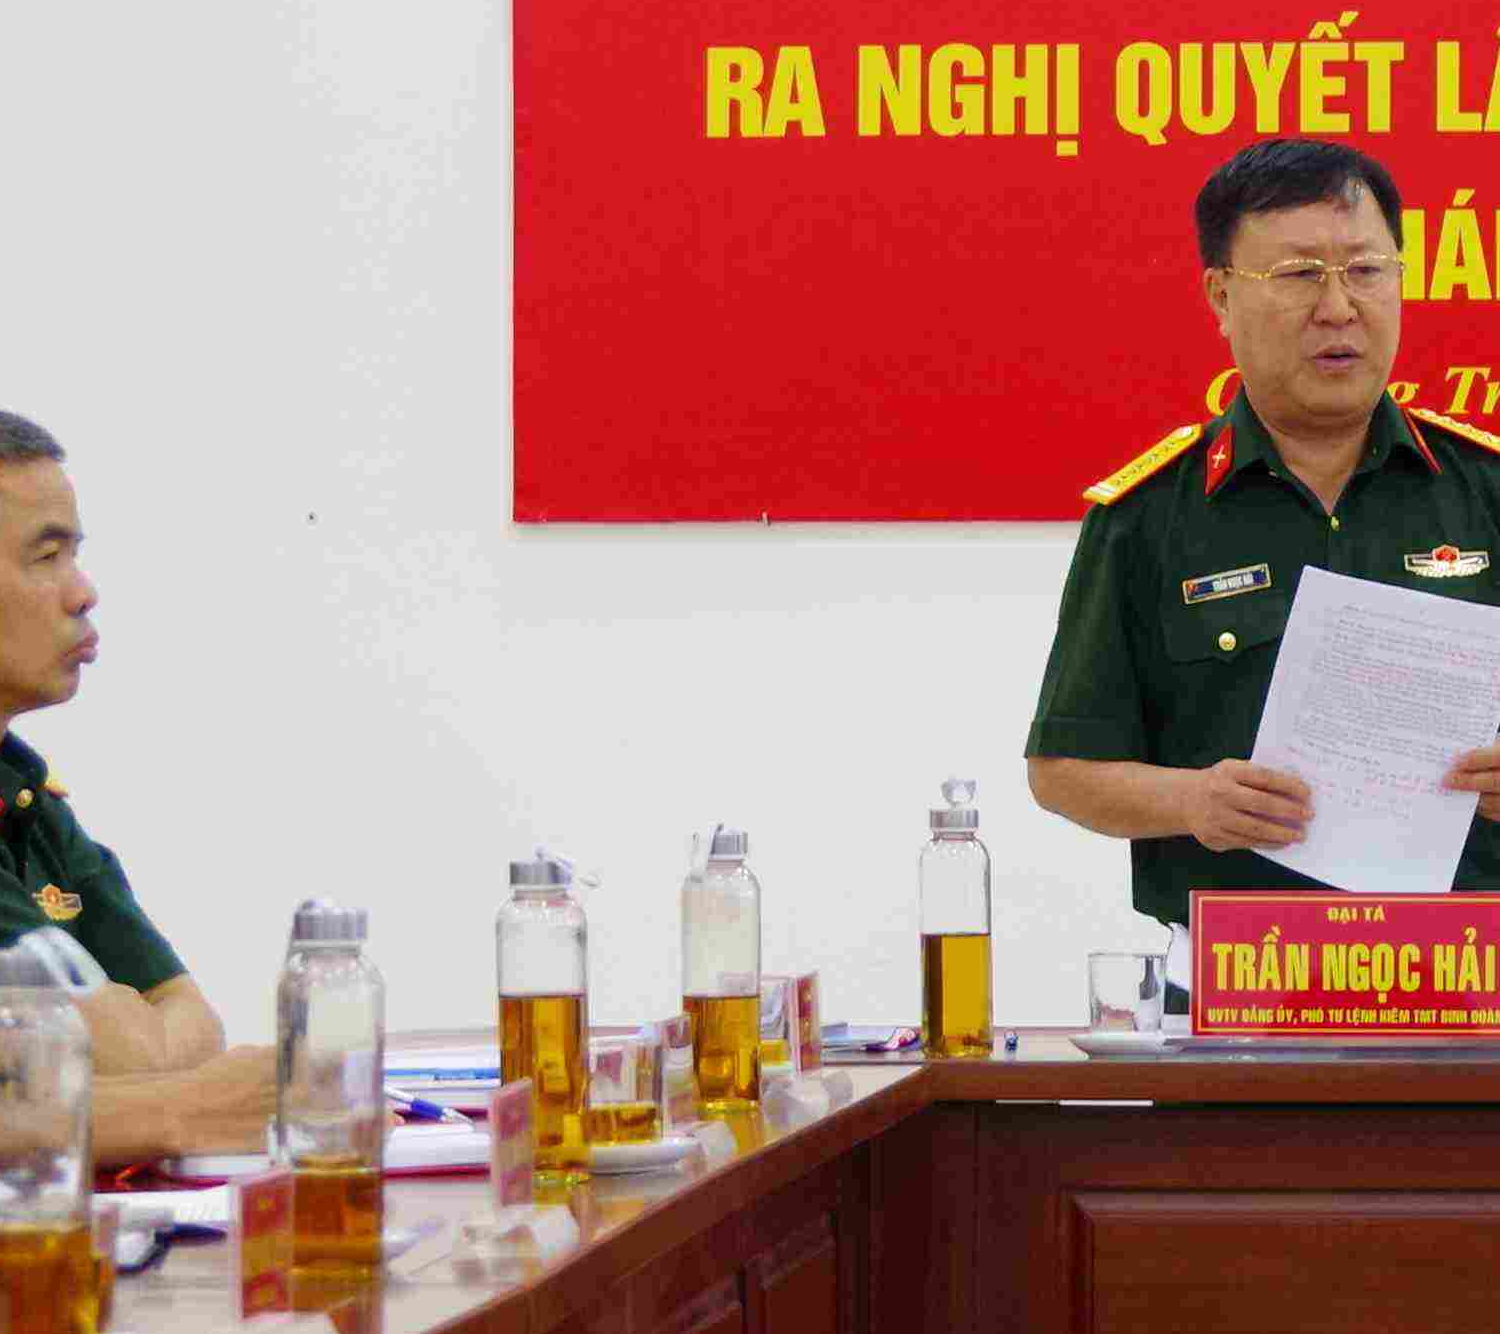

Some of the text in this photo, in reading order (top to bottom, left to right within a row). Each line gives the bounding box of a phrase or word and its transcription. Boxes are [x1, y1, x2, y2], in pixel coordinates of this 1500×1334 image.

[706, 45, 826, 140] RA
[857, 42, 1080, 157] NGHỊ
[1115, 10, 1405, 147] QUYẾT
[1212, 926, 1497, 1004] TRẦN NGỌC HẢI
